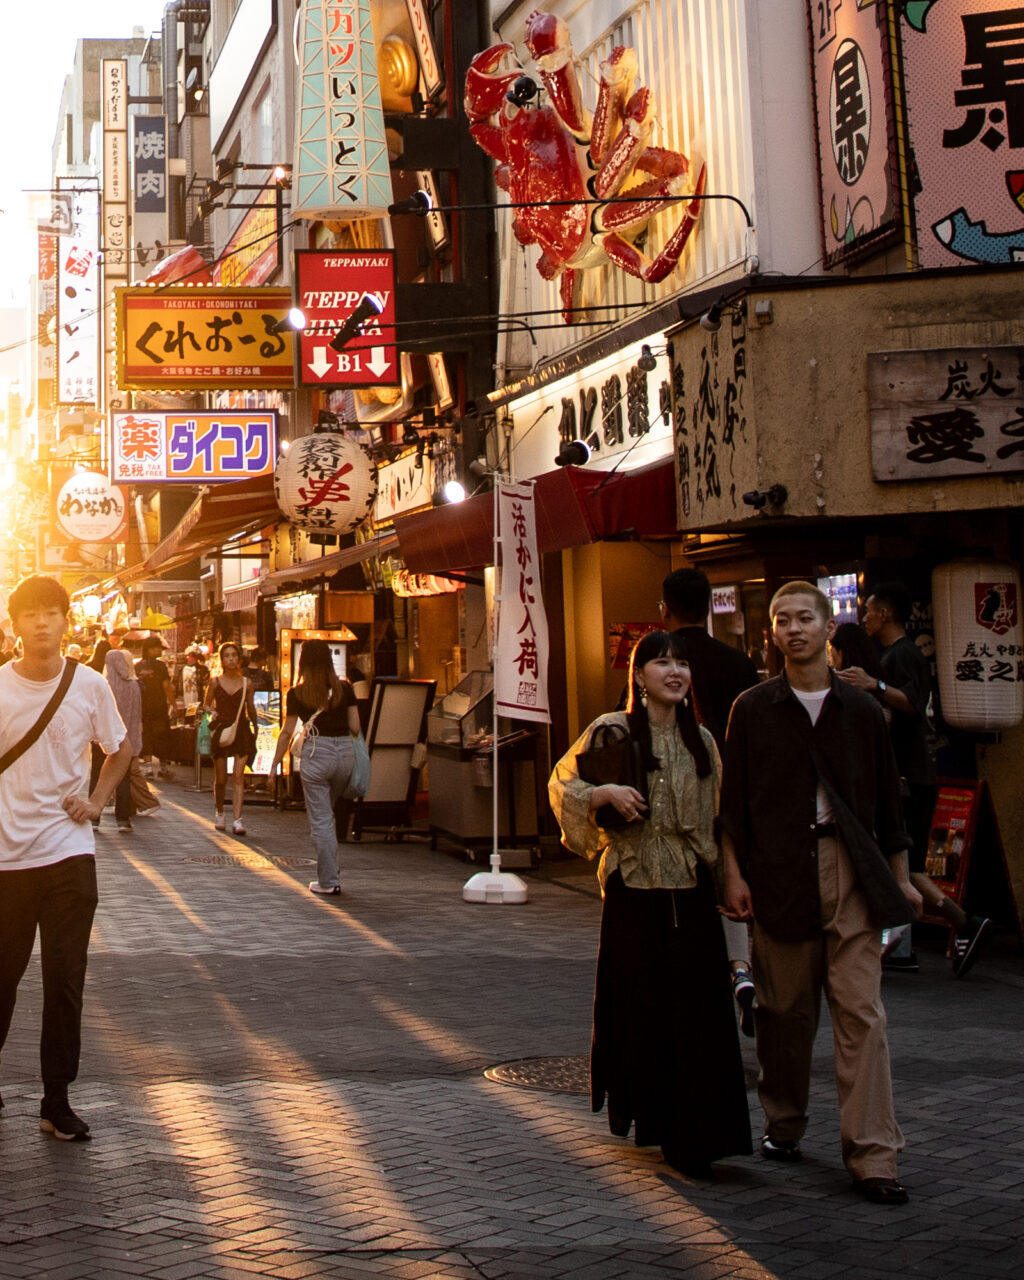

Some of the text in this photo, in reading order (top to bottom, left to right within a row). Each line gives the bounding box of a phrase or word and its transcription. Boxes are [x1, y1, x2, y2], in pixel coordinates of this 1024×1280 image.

[135, 131, 165, 198] 焼肉
[323, 258, 389, 267] TEPPANYAKI
[135, 311, 286, 364] くれおーる
[337, 354, 362, 372] B1
[121, 415, 159, 460] 薬
[169, 420, 270, 473] ダイコク
[119, 463, 144, 477] 免税
[511, 502, 539, 680] 活かに入荷
